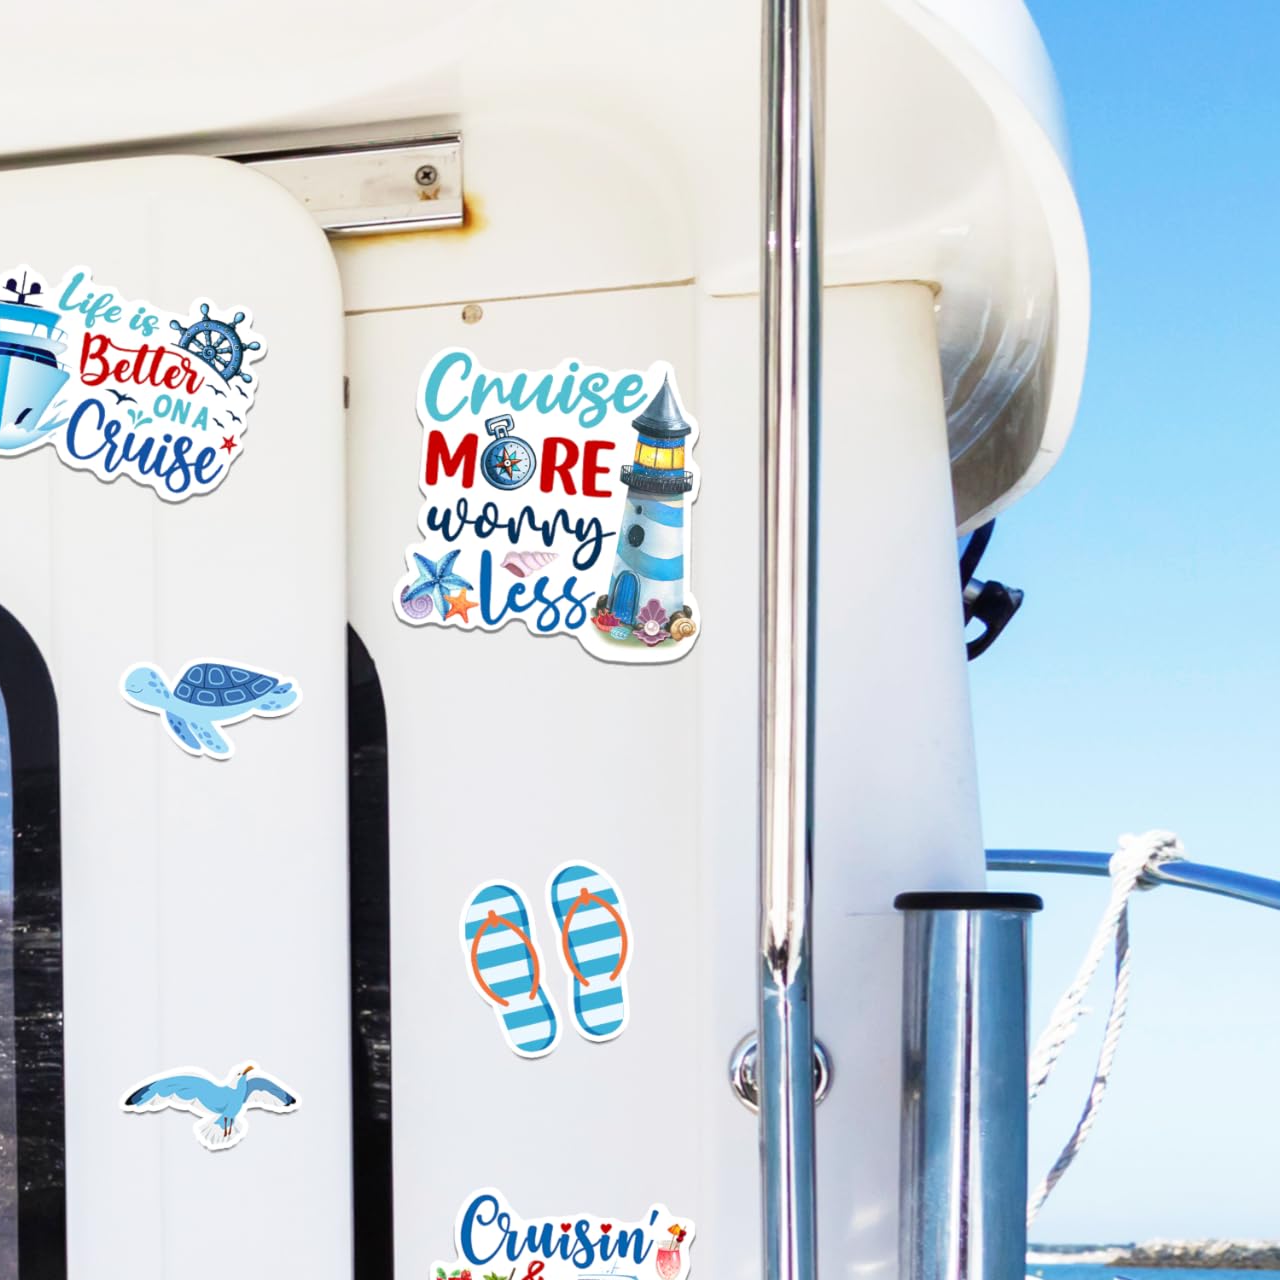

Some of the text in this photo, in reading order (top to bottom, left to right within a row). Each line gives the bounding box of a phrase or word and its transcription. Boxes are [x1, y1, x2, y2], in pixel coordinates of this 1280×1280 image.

[58, 272, 159, 337] Life is
[79, 332, 205, 394] Better
[425, 352, 648, 428] Cruise
[66, 398, 223, 493] Cruise
[153, 394, 209, 431] ON A
[426, 498, 616, 571] worry
[480, 549, 595, 632] less
[460, 1194, 659, 1269] Cruisin'
